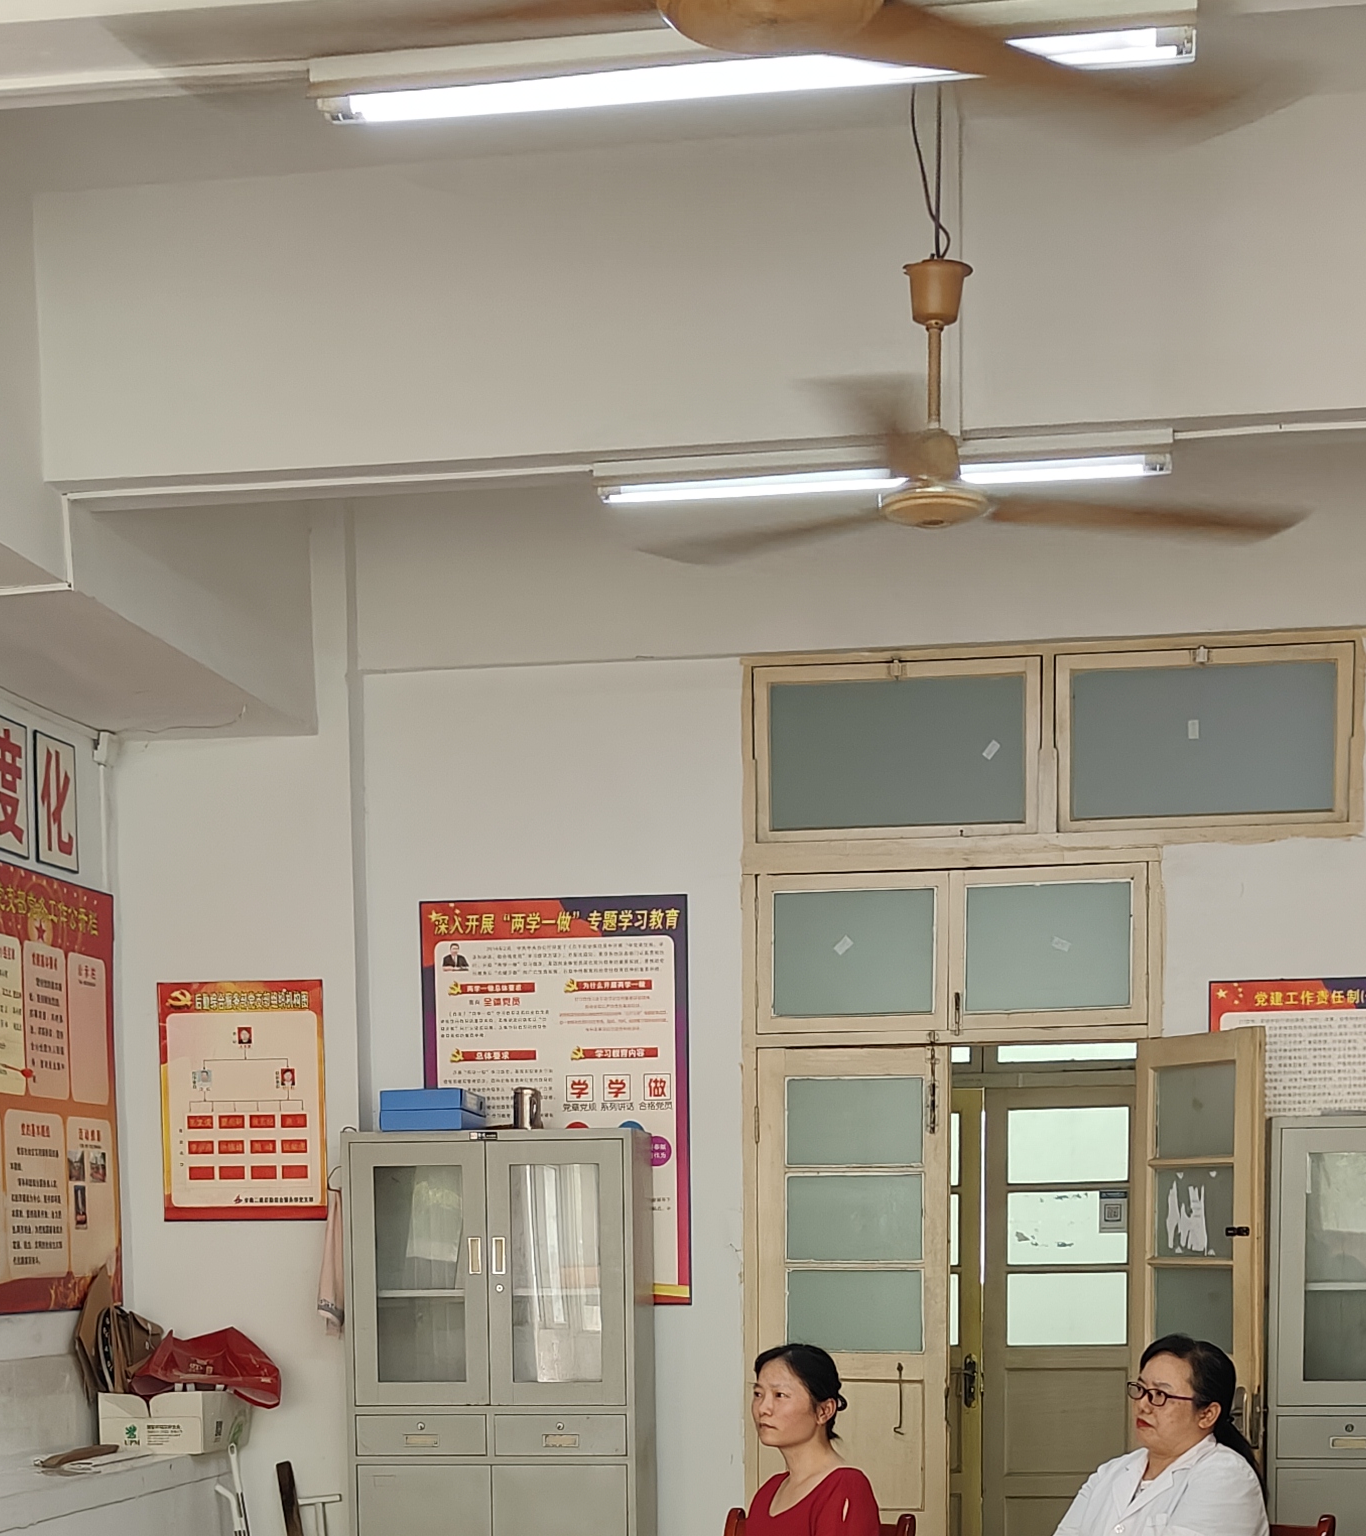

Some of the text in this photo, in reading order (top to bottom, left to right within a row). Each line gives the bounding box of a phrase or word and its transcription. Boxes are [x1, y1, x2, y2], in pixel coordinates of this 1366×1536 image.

[594, 1048, 646, 1059] 学习教育内容
[570, 1080, 589, 1099] 学
[607, 1079, 626, 1098] 学
[648, 1078, 667, 1098] 做
[638, 1101, 674, 1112] 合格党员
